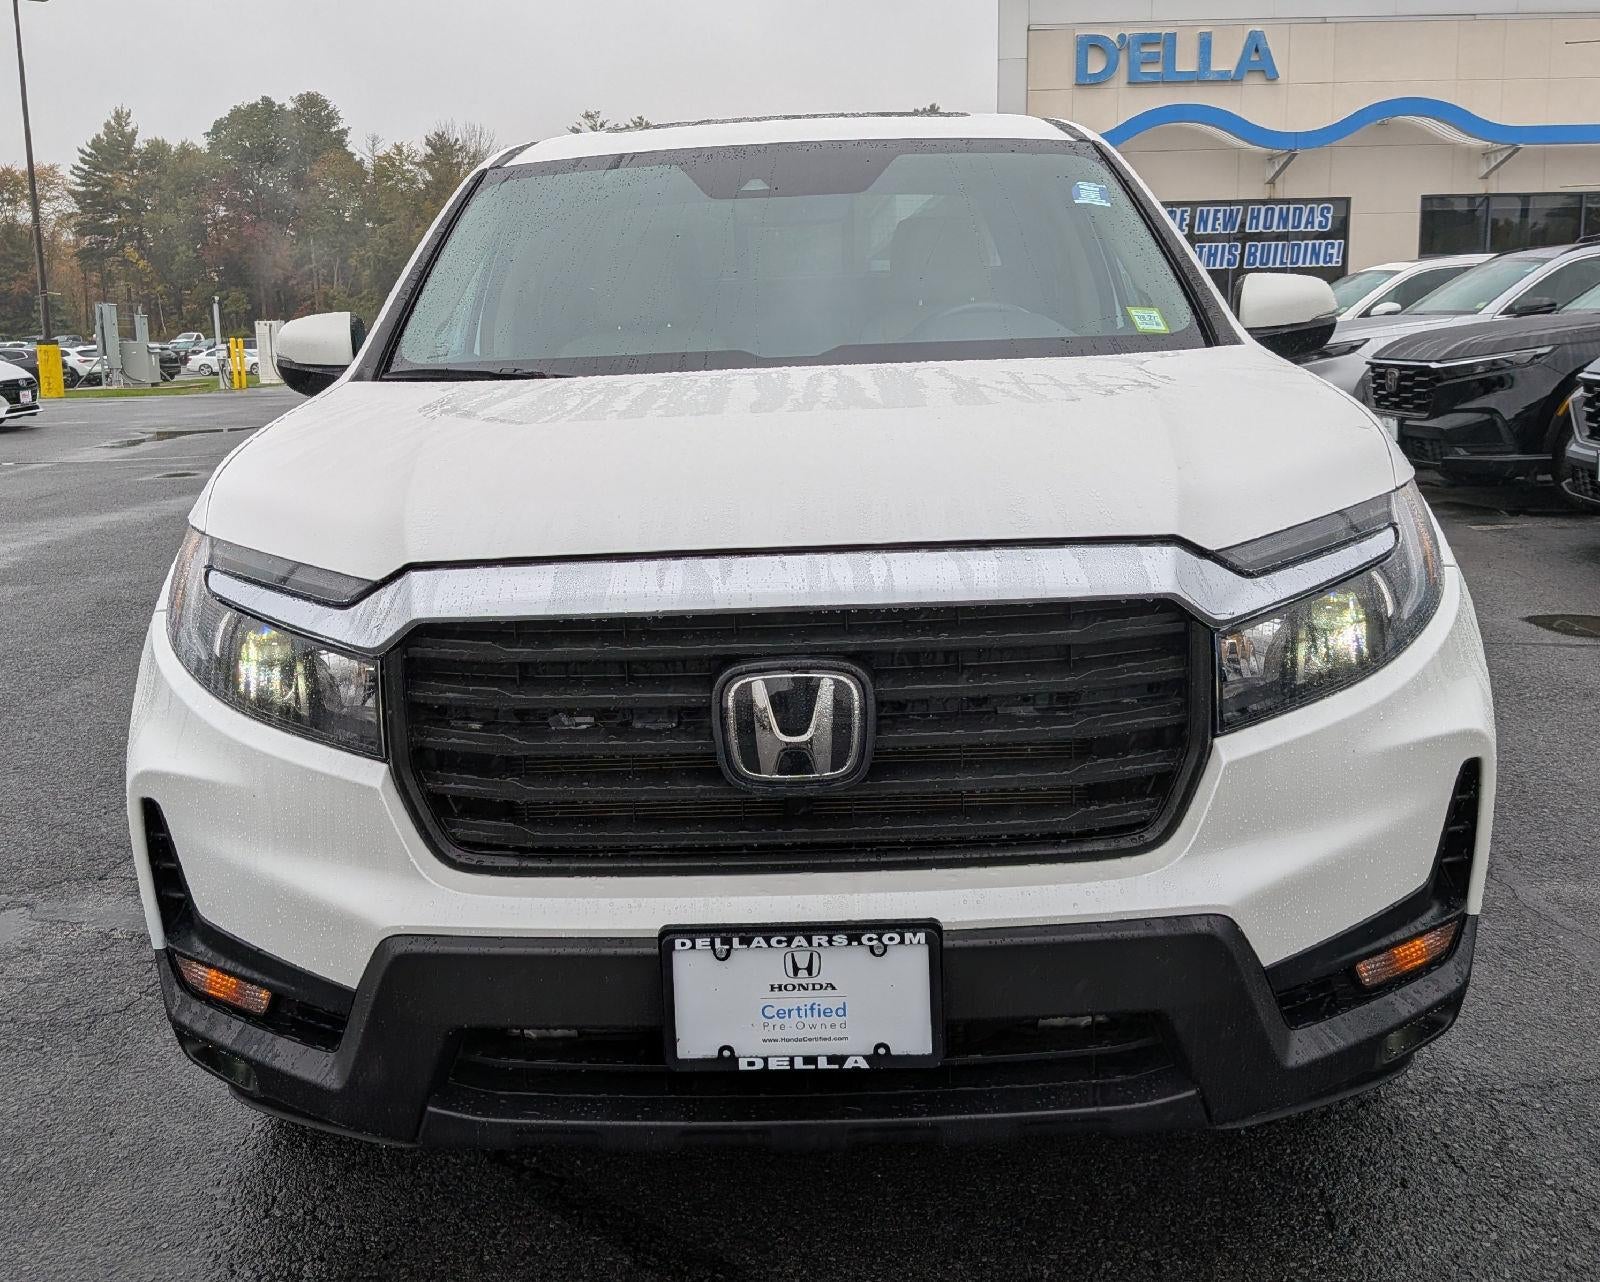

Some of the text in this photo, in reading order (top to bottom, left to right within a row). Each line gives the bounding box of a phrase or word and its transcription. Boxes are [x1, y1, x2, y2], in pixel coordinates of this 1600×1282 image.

[1074, 29, 1280, 86] D'ELLA
[1194, 205, 1243, 235] NEW
[1245, 203, 1334, 233] HONDAS
[1195, 239, 1345, 270] THIS BUILDING!
[674, 932, 926, 951] DELLACARS.COM
[768, 982, 838, 992] HONDA
[761, 1001, 847, 1020] Certified
[762, 1020, 847, 1031] Pre-Owned
[761, 1035, 849, 1043] www.HondaCertified.com
[738, 1056, 870, 1071] DELLA
